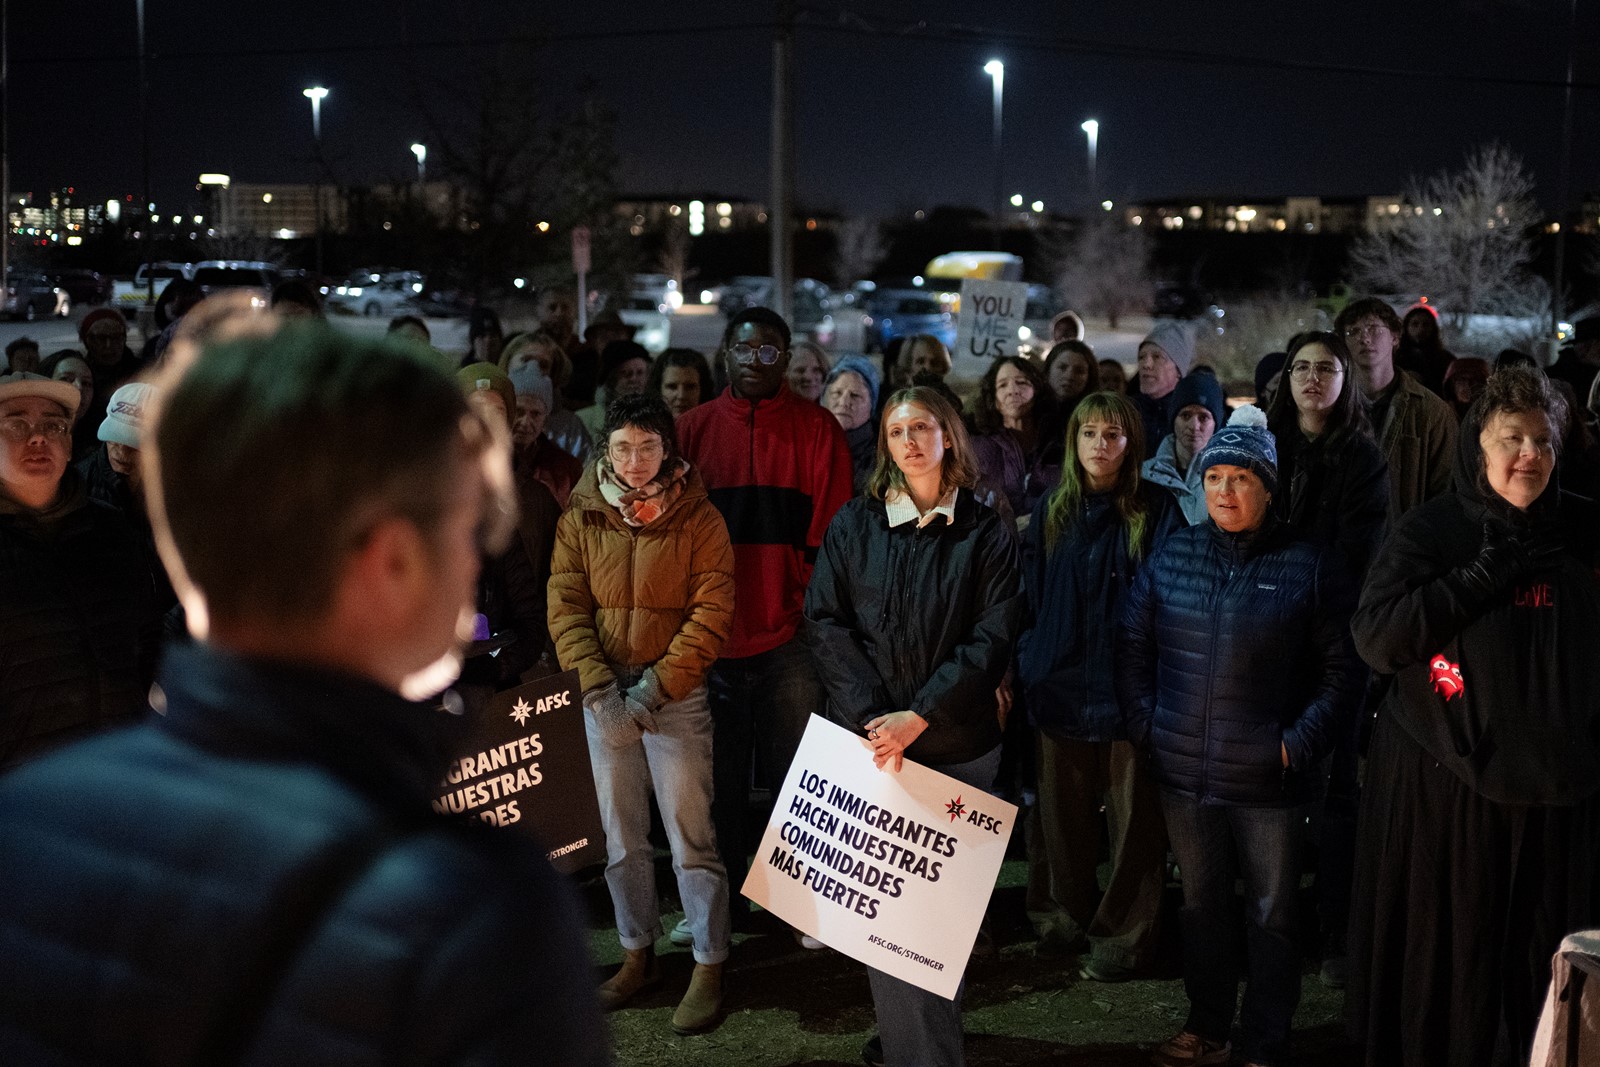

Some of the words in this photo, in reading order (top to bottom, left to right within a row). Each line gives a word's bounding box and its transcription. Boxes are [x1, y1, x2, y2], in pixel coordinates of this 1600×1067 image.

[973, 295, 1014, 318] YOU.
[536, 690, 571, 715] AFSC
[441, 733, 544, 787] GRANTES
[789, 794, 841, 837] HACEN
[839, 821, 944, 884] NUESTRAS
[798, 769, 829, 799] LOS
[828, 784, 958, 858] INMIGRANTES
[966, 809, 1003, 836] AFSC
[768, 847, 805, 881] MÁS
[802, 865, 881, 921] FUERTES
[780, 820, 906, 899] COMUNIDADES
[867, 933, 945, 973] AFSC.ORG/STRONGER
